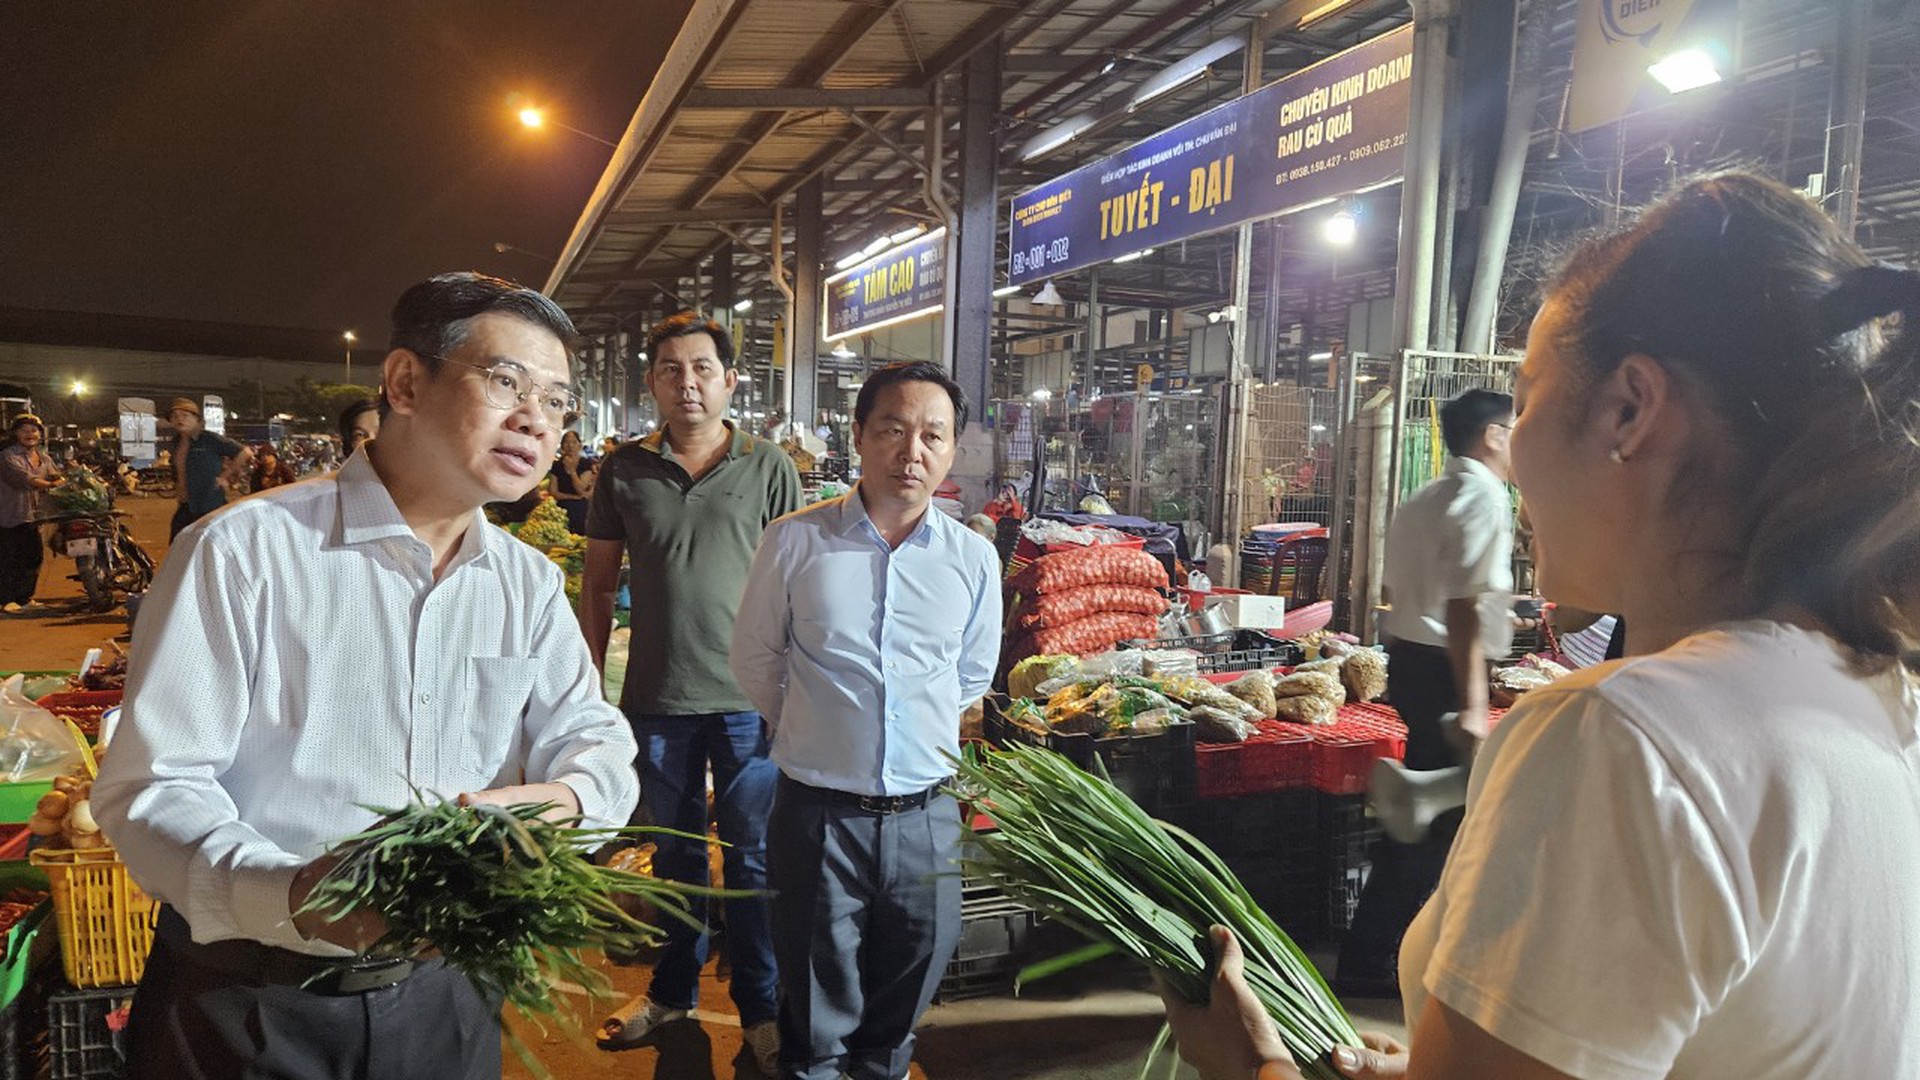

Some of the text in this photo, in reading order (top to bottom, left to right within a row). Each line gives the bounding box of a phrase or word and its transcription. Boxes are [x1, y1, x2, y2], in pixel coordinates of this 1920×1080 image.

[1280, 86, 1329, 127] CHUYÊN
[1331, 72, 1365, 108] KINH
[1278, 104, 1353, 159] RAU CỦ QUẢ
[1100, 171, 1165, 240] TUYẾT
[1188, 154, 1235, 215] ĐẠI
[863, 264, 888, 306] TÁM
[889, 256, 915, 297] CAO
